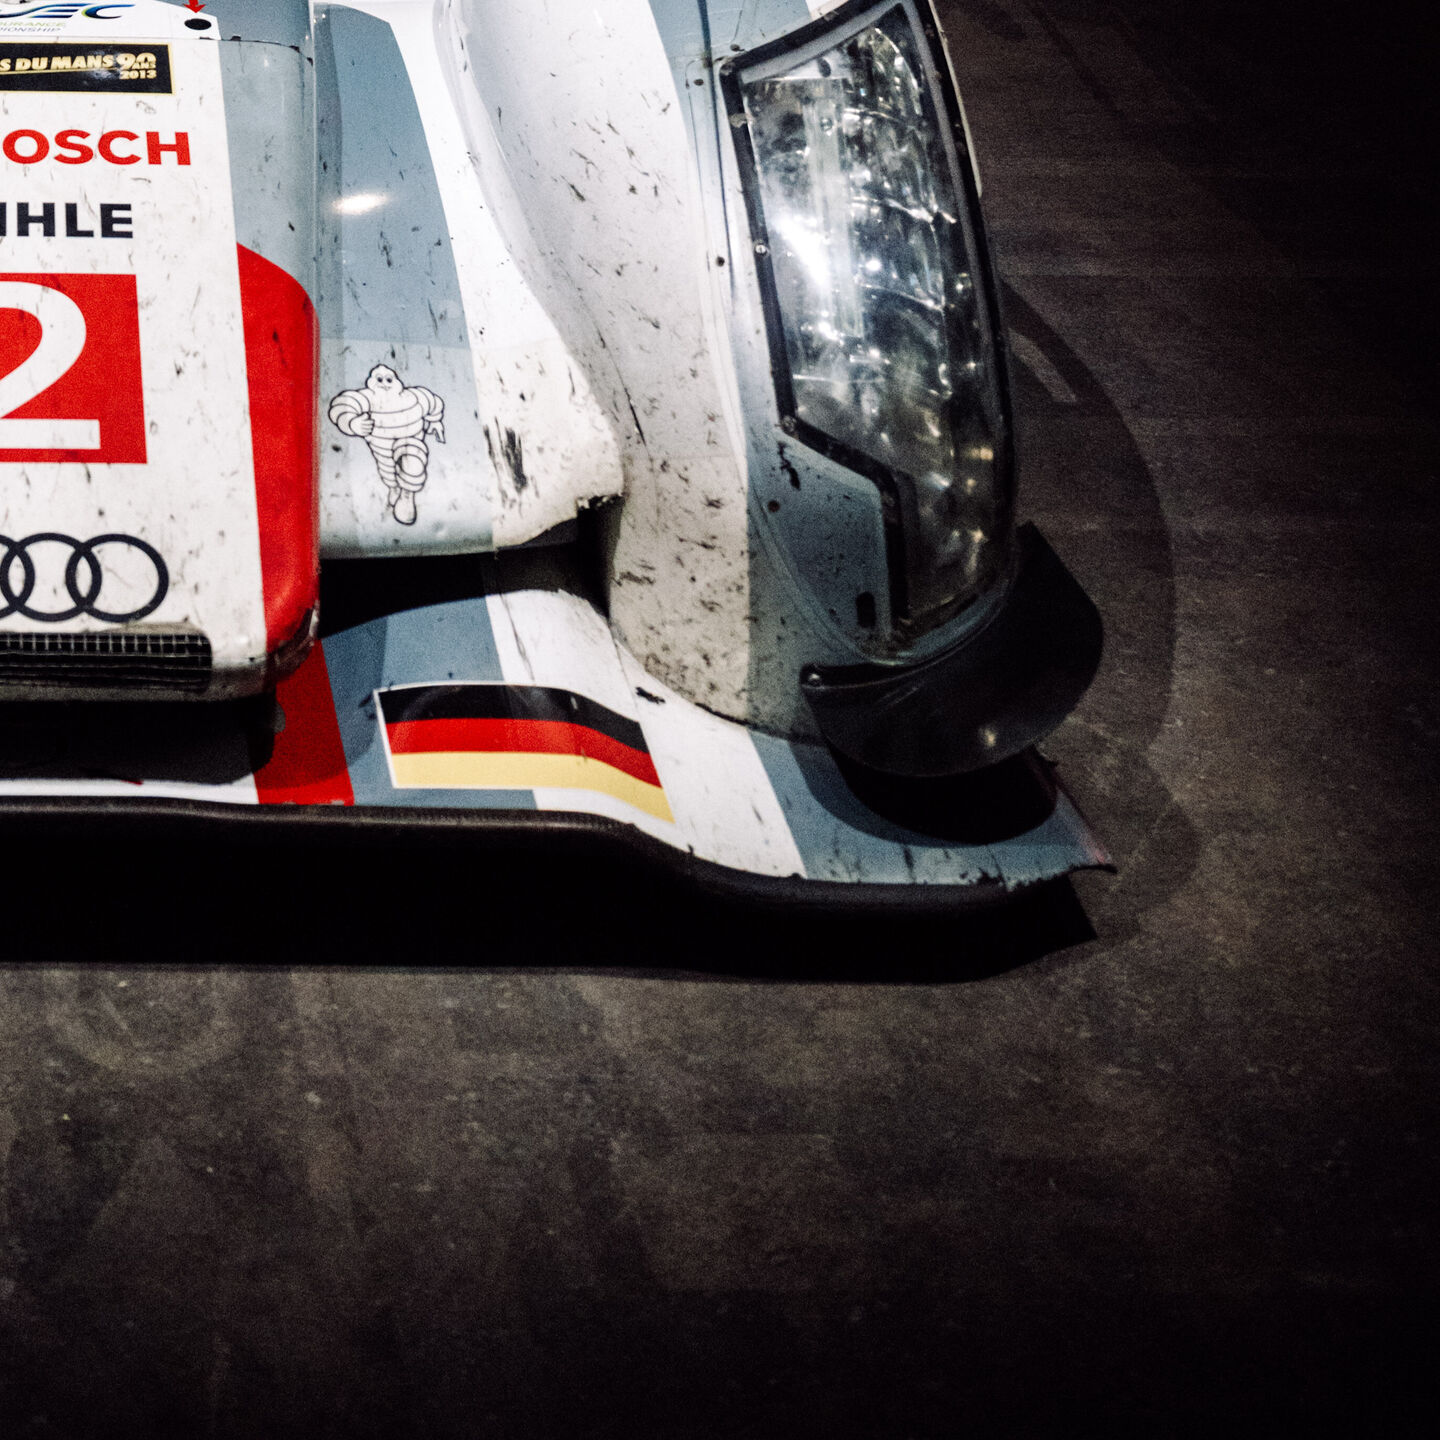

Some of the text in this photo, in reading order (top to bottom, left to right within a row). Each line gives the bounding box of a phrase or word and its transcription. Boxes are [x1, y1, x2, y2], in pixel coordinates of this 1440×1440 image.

[15, 57, 49, 71] DU
[50, 54, 114, 70] MANS
[116, 52, 157, 70] 90
[119, 69, 157, 80] 2013
